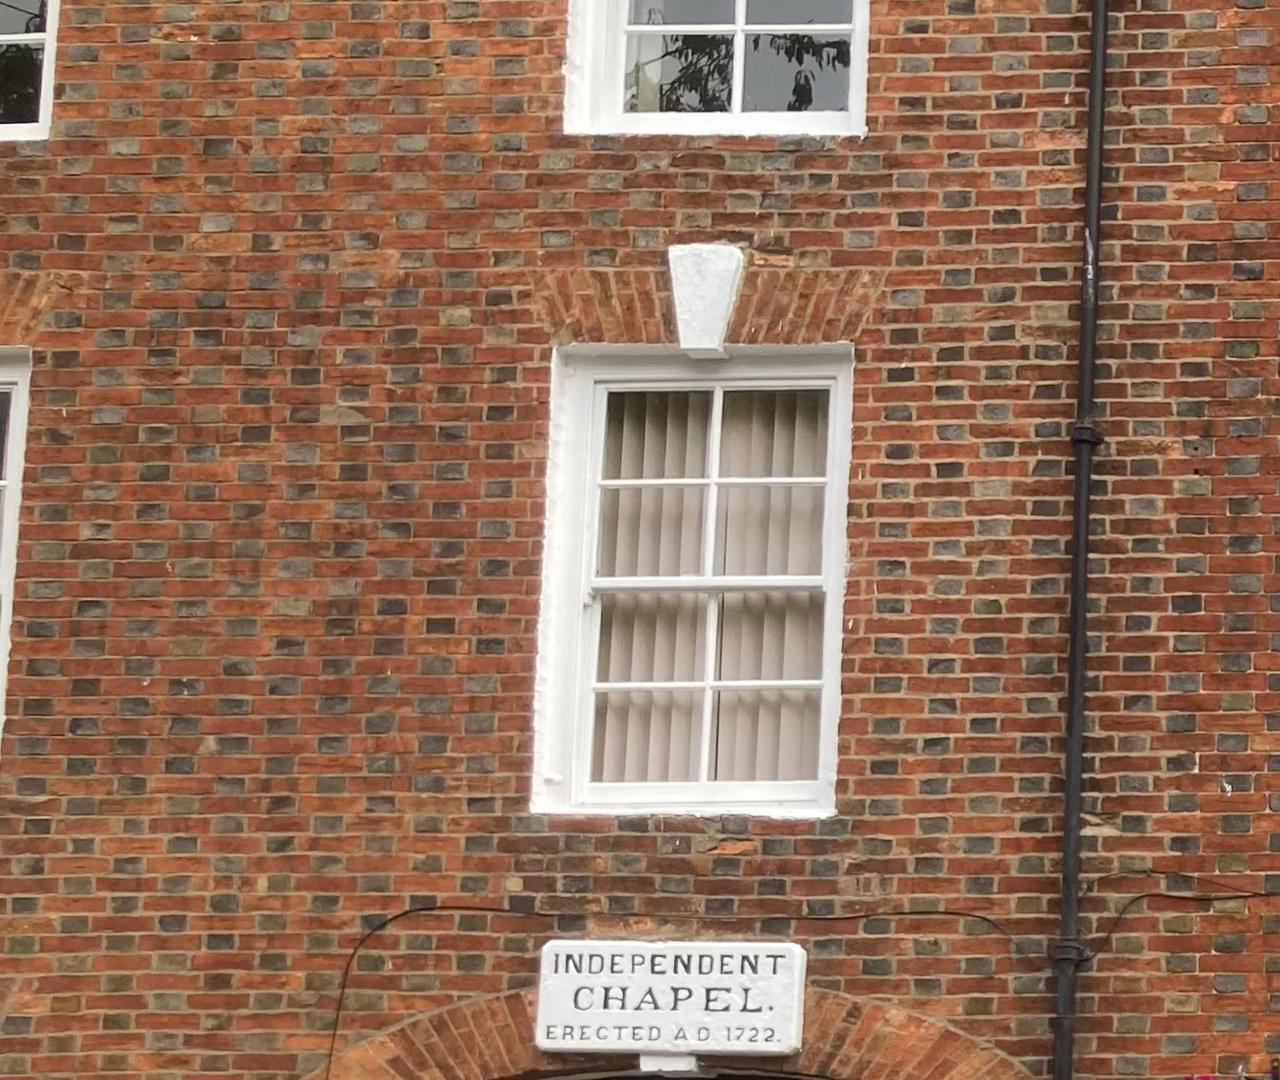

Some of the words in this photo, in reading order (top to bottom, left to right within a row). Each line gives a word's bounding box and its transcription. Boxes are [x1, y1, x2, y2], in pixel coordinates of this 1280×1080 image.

[553, 953, 786, 975] INDEPENDENT
[573, 986, 775, 1013] CHAPEL.
[545, 1024, 662, 1042] ERECTED
